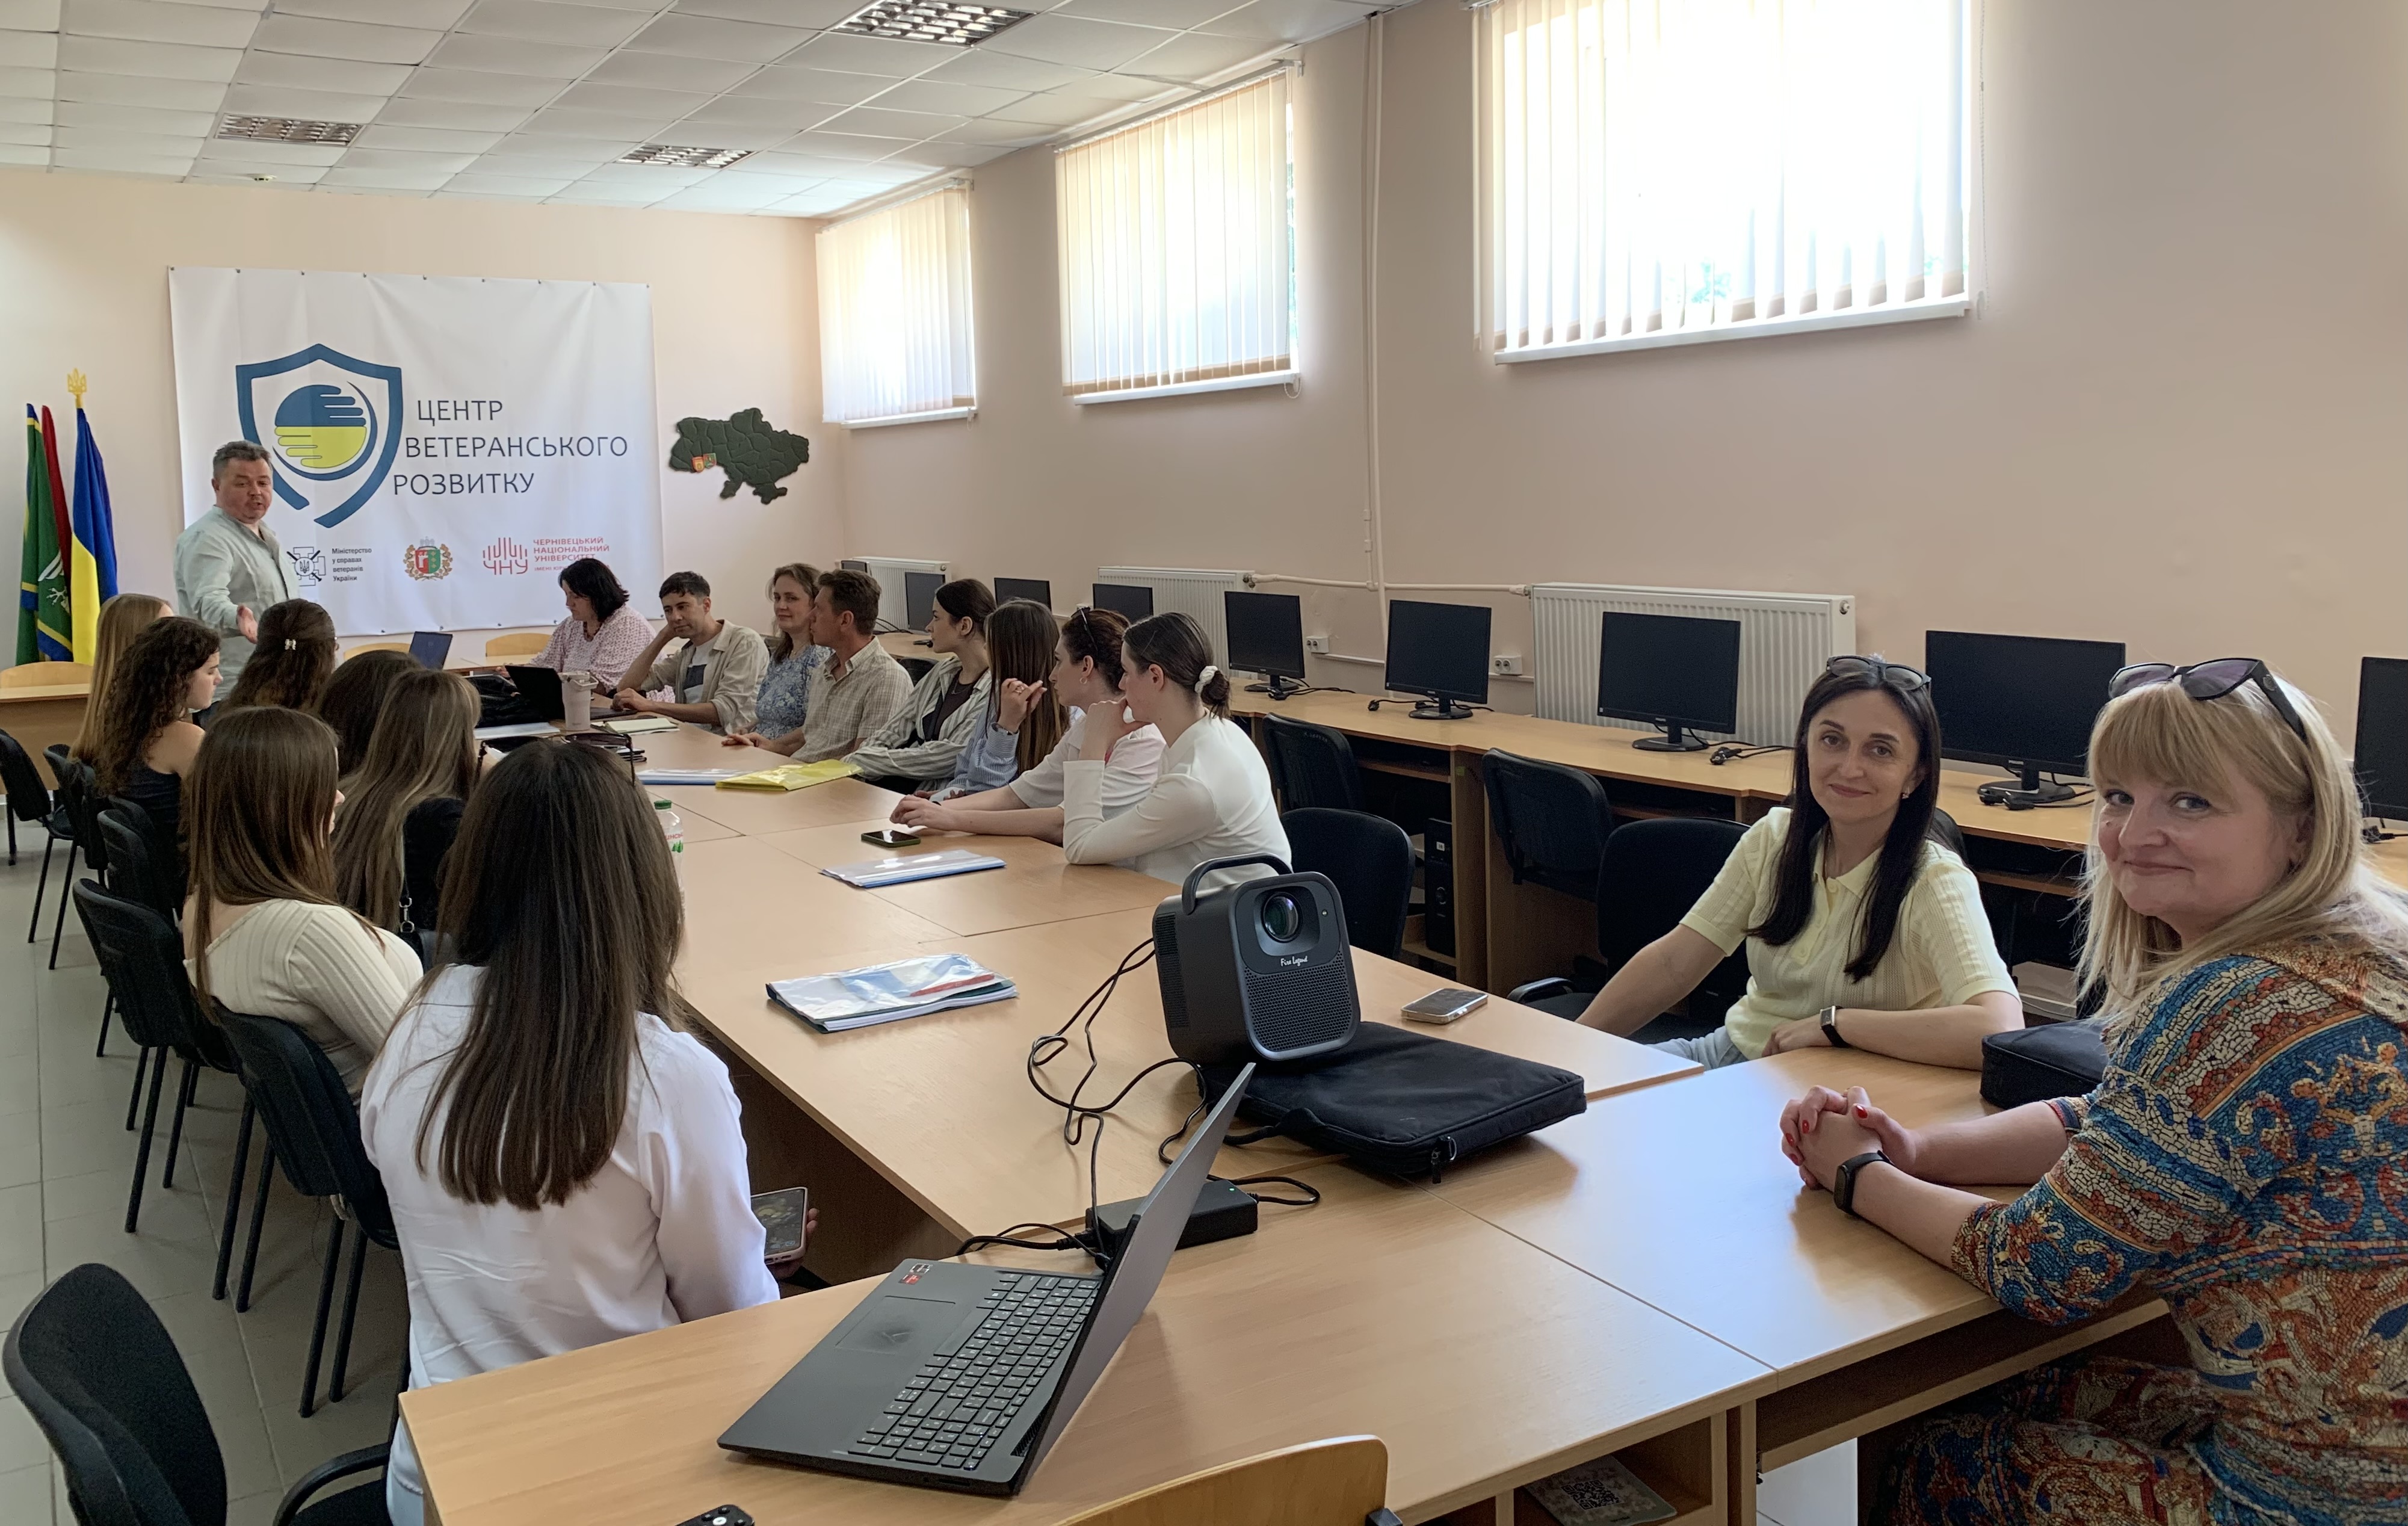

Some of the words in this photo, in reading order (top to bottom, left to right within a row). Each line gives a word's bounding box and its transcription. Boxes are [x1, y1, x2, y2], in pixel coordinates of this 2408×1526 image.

[417, 400, 503, 427] ЦЕНТР
[406, 436, 628, 458] ВЕТЕРАНСЬКОГО
[393, 472, 534, 495] РОЗВИТКУ
[533, 537, 604, 545] ЧЕРНІВЕЦЬКИЙ
[533, 545, 610, 554] НАЦІОНАЛЬНИЙ
[483, 559, 528, 575] ЧНУ
